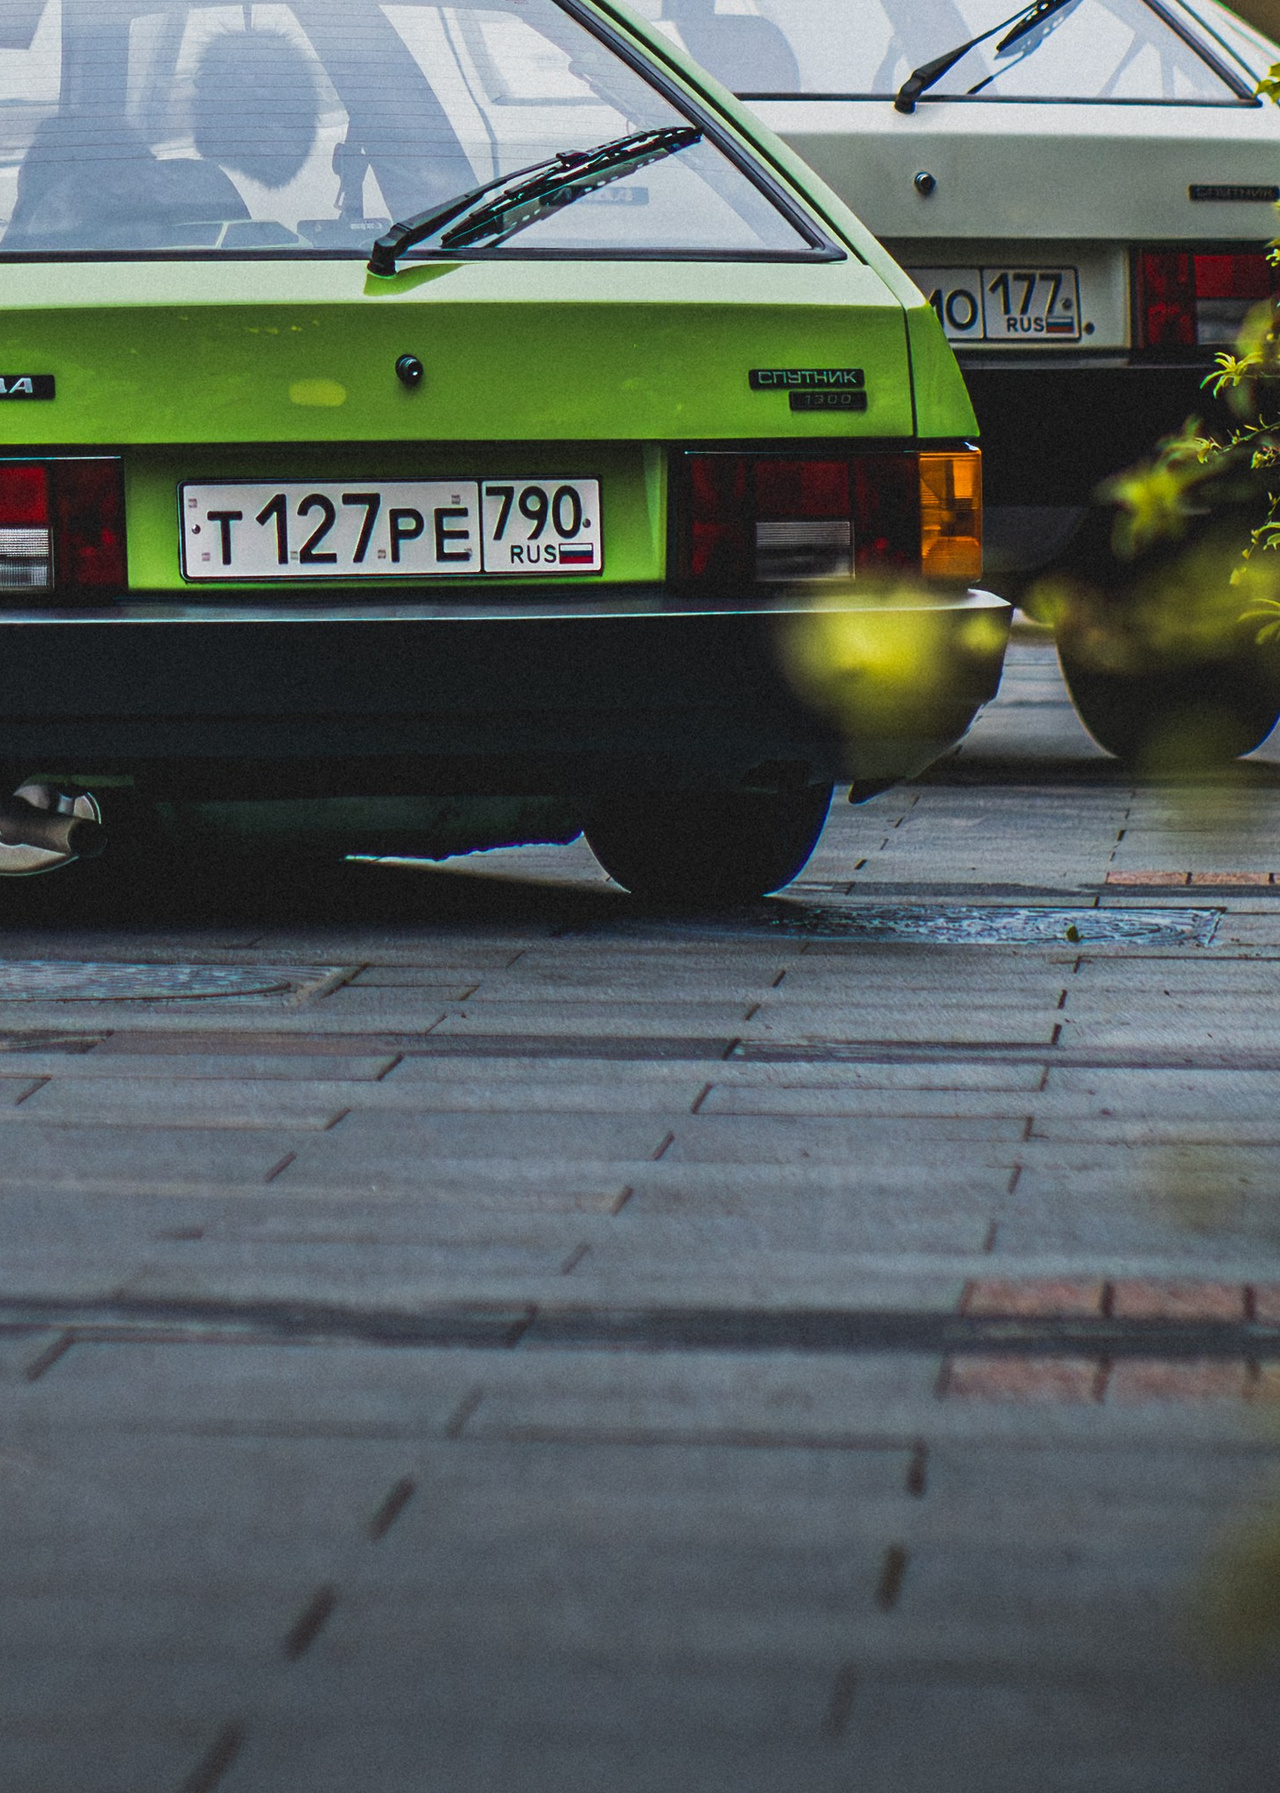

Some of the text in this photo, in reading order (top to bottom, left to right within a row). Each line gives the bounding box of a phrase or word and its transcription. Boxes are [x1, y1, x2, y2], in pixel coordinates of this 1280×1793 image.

[988, 272, 1063, 315] 177
[1006, 316, 1045, 333] RUS
[758, 371, 857, 383] СПУТНИК
[804, 394, 852, 405] 1300
[485, 485, 583, 541] 790
[510, 543, 557, 564] RUS
